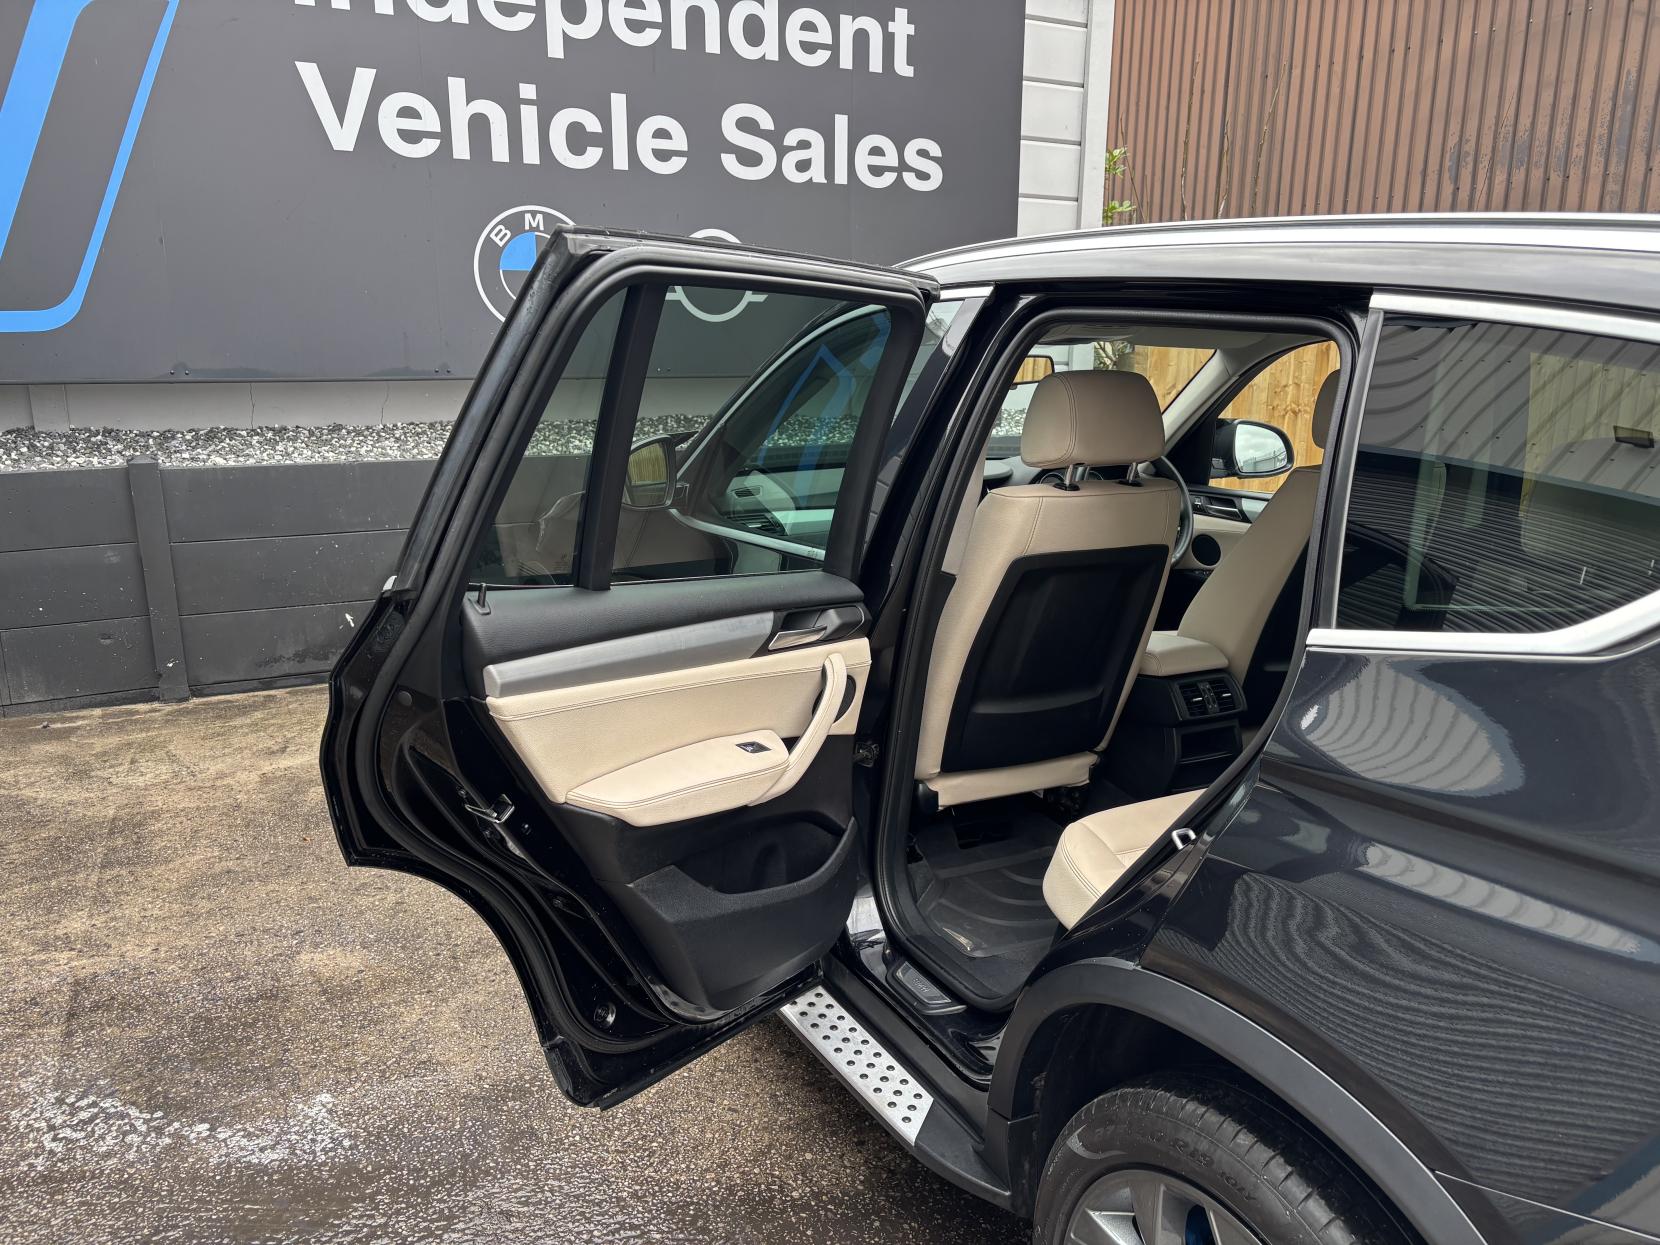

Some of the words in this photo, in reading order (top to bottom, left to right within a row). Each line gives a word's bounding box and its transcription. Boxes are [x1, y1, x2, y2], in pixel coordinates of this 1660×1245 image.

[294, 0, 915, 77] pendent
[294, 60, 688, 175] Vehicle
[720, 102, 943, 192] Sales
[489, 212, 545, 248] BM
